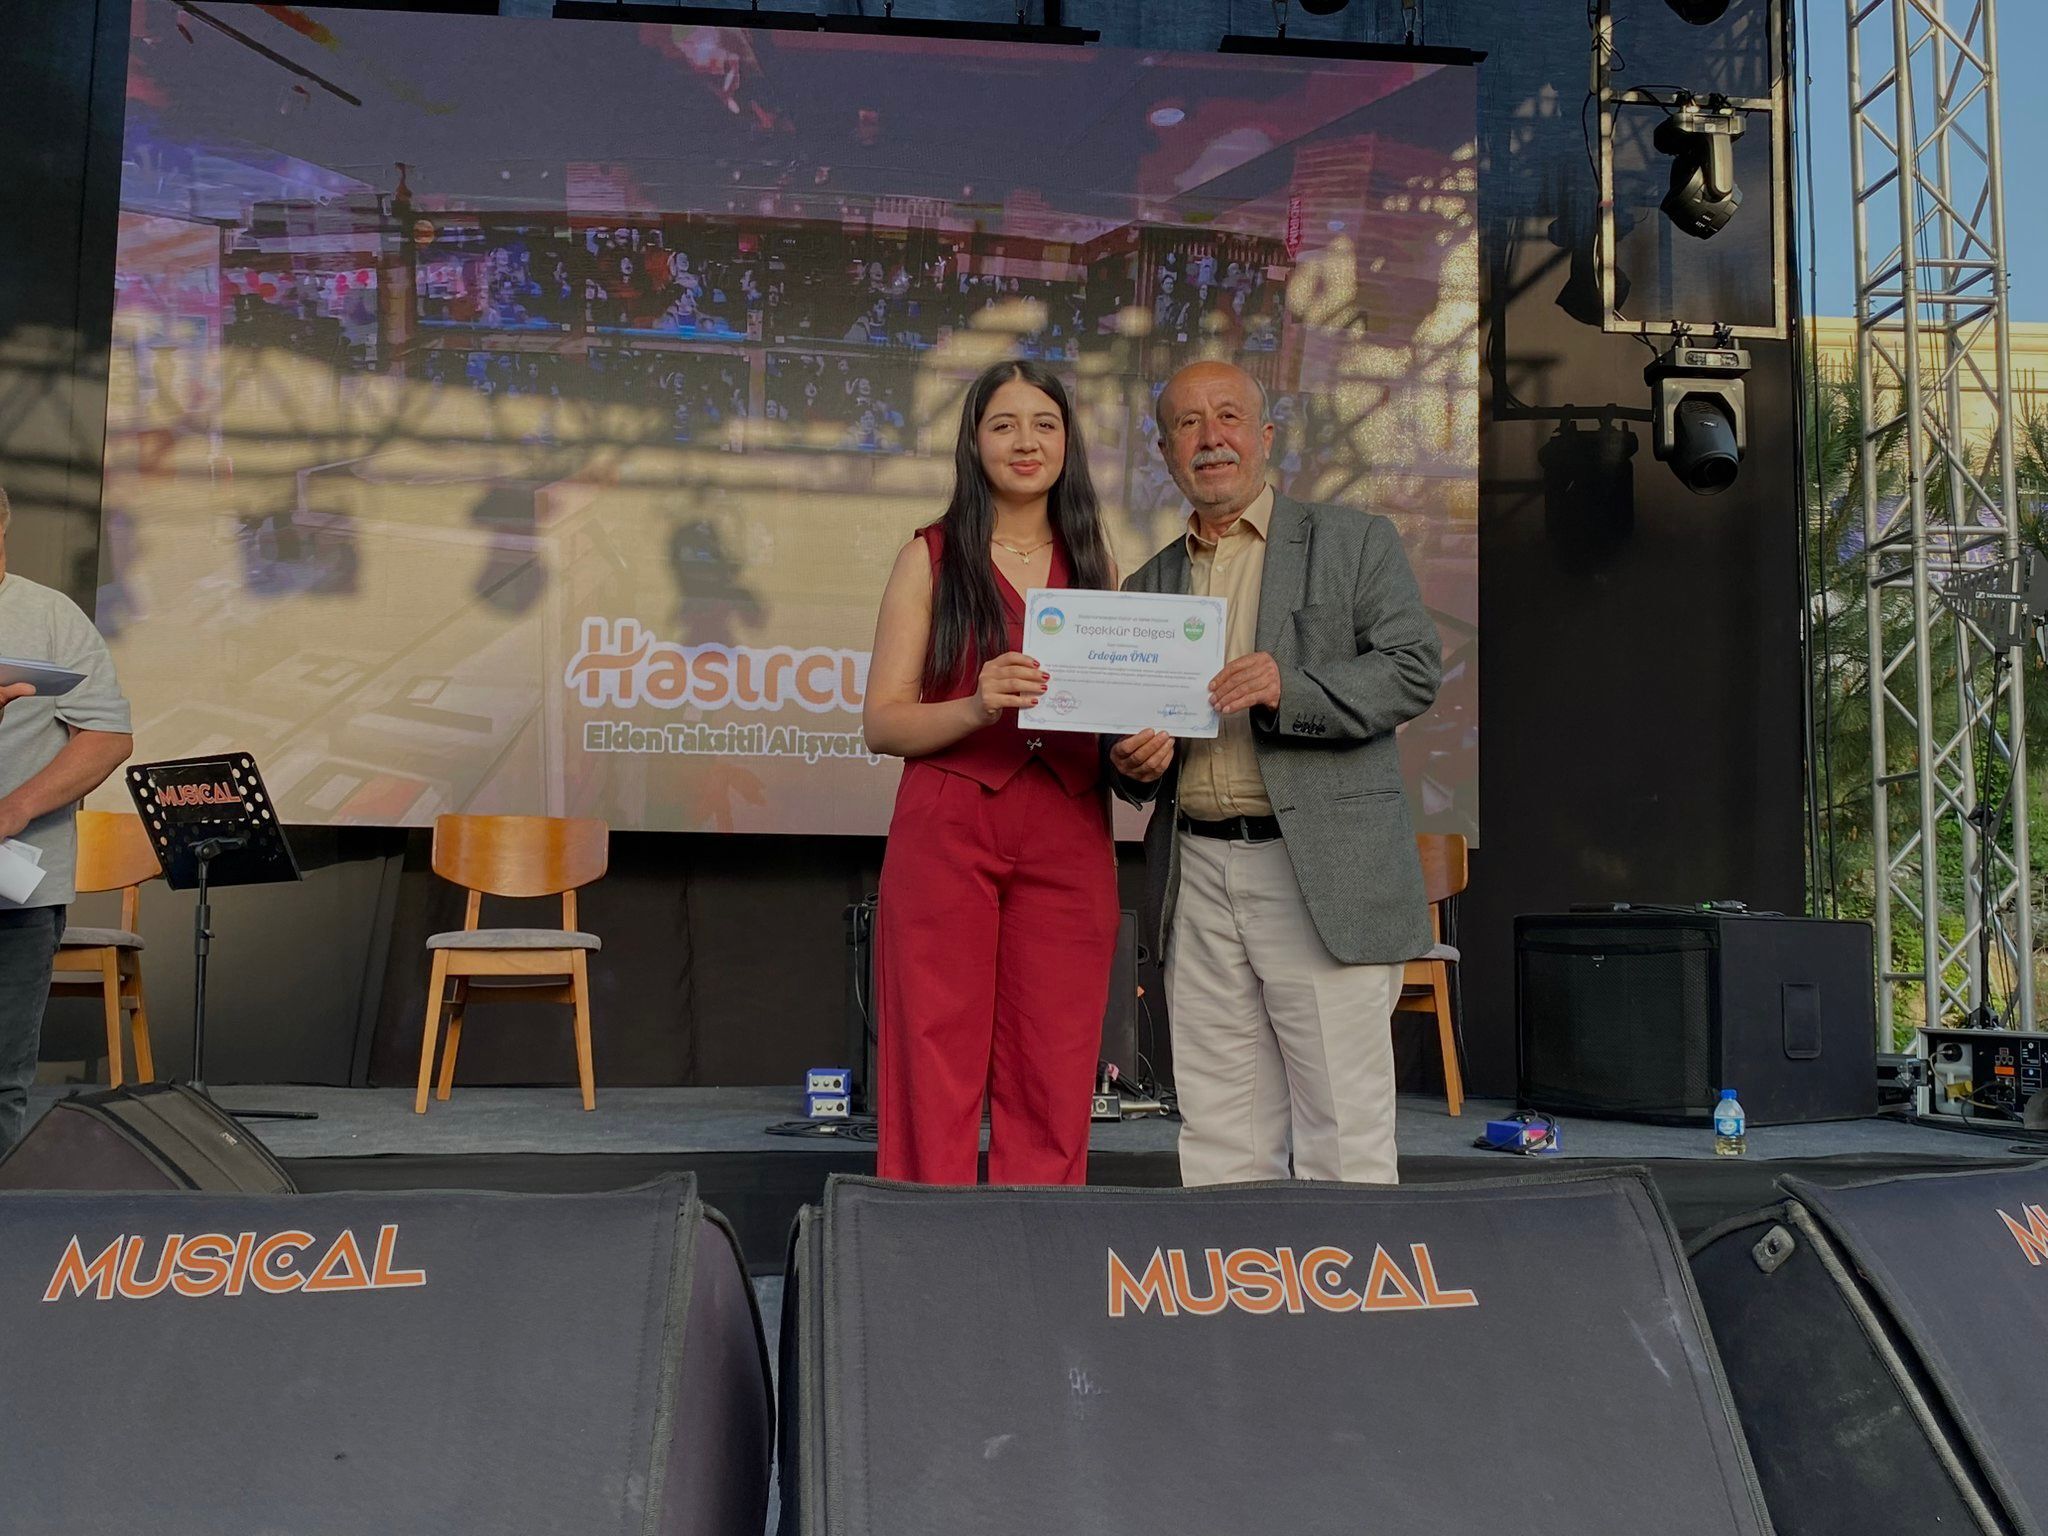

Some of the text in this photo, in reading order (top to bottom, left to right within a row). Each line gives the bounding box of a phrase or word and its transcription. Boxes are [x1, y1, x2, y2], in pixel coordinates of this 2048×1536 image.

[1074, 624, 1131, 637] Teşekkür
[1132, 627, 1176, 640] Belgesi
[1087, 649, 1128, 663] Erdoğan
[585, 722, 881, 764] Elden Taksitli Alışveri
[156, 782, 242, 807] MUSICAL
[42, 1224, 426, 1301] MUSICAL
[1108, 1243, 1479, 1317] MUSICAL
